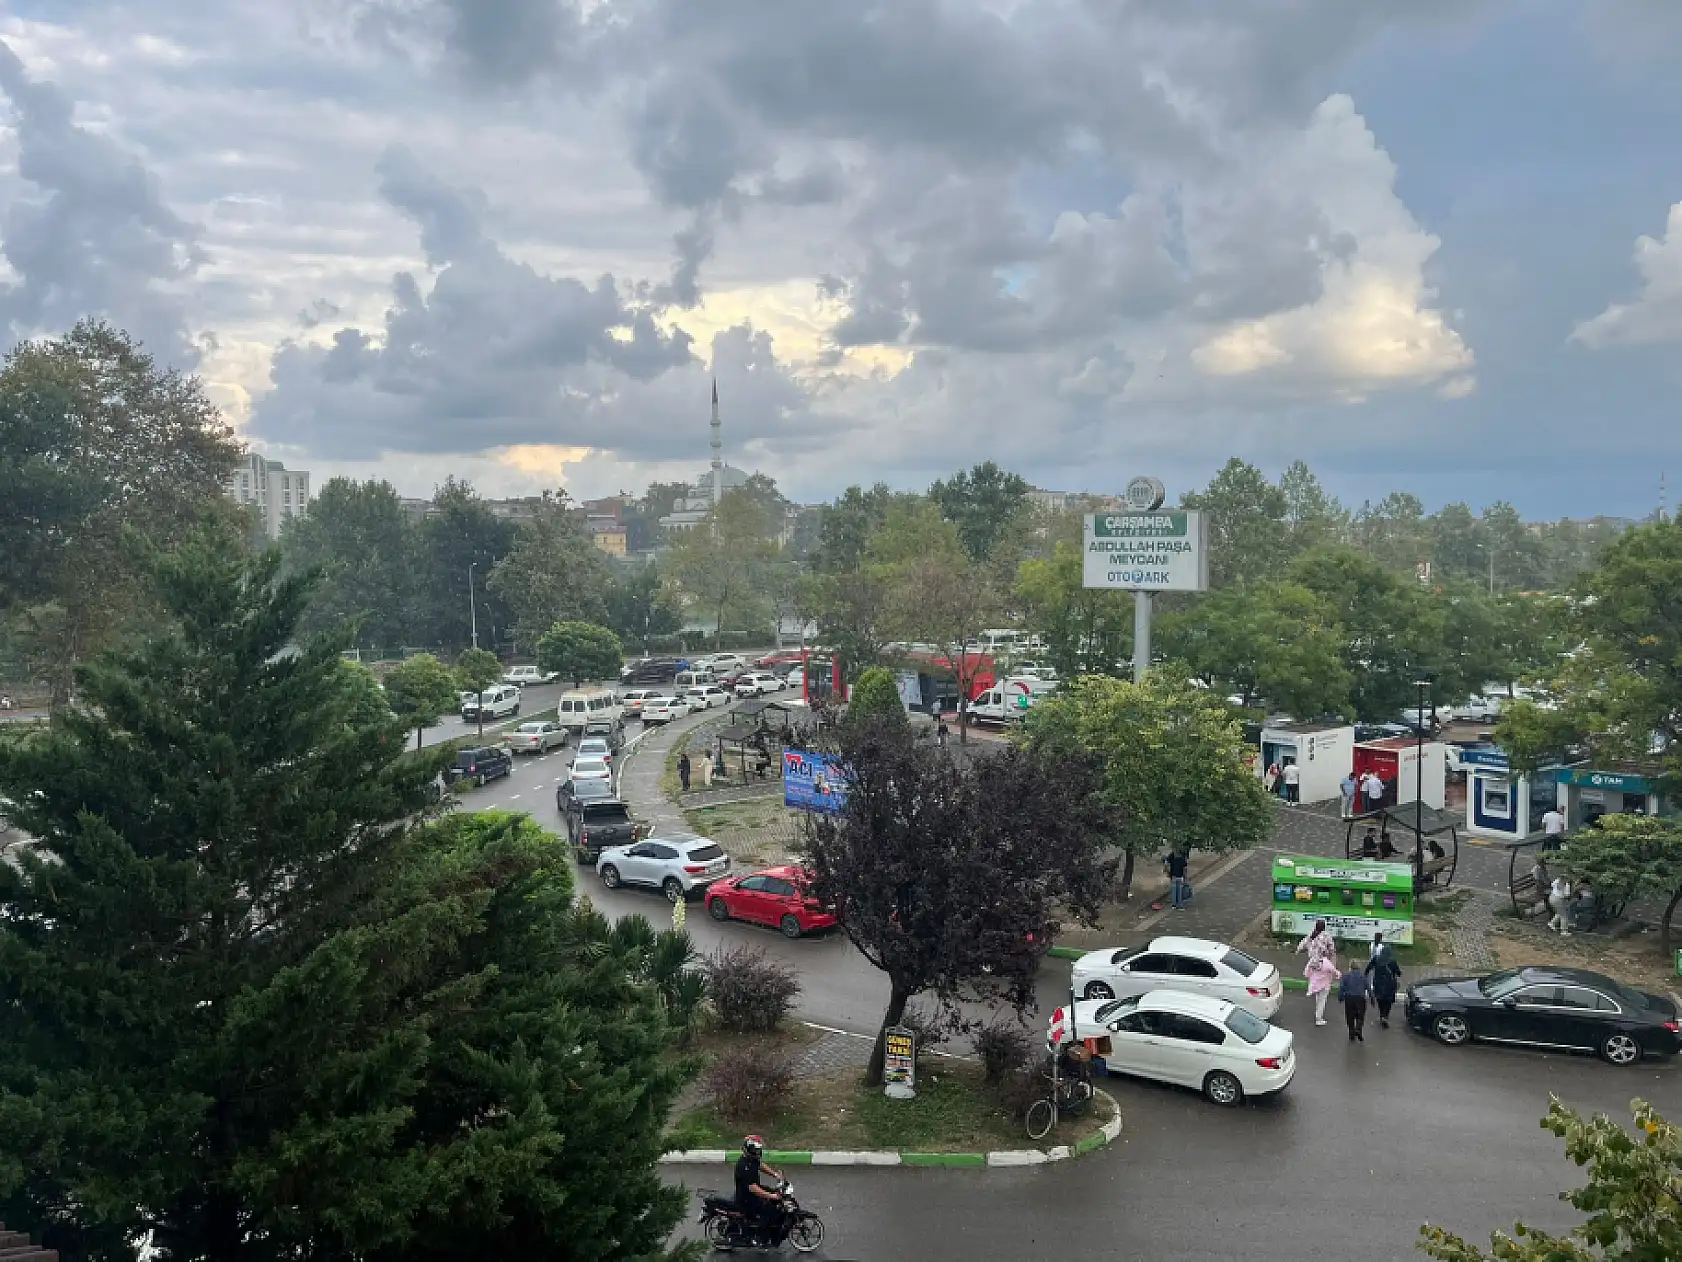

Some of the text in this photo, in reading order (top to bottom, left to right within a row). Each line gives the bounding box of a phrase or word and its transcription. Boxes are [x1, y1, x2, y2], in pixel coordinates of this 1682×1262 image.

[1089, 541, 1192, 555] ABDULLAH PAŞA
[1109, 554, 1169, 565] MEYDANI
[1107, 569, 1170, 583] OTOPARK
